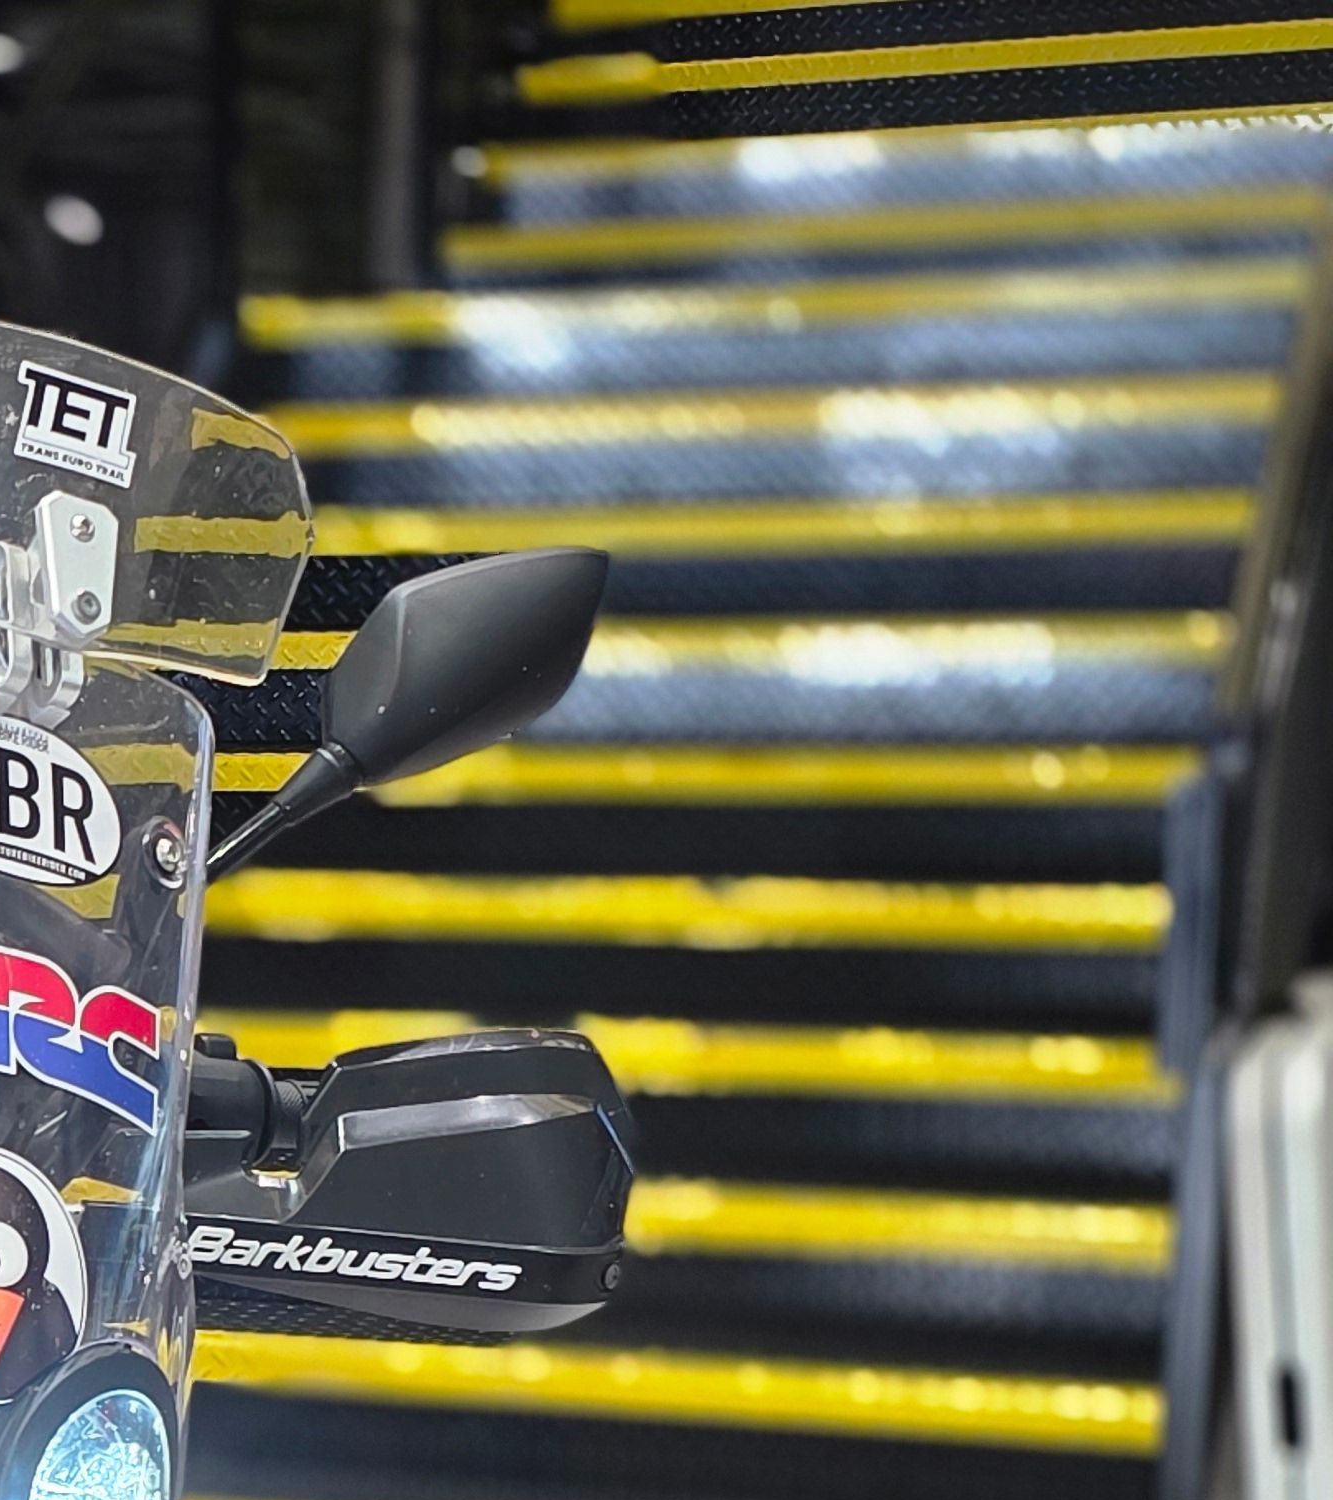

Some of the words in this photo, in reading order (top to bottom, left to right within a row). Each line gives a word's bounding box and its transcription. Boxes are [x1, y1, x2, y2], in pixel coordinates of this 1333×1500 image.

[25, 367, 130, 449] TET
[21, 442, 60, 461] TRANS
[62, 453, 93, 471] EURO
[96, 464, 126, 482] TRAIL
[187, 1225, 523, 1291] Barkbusters
